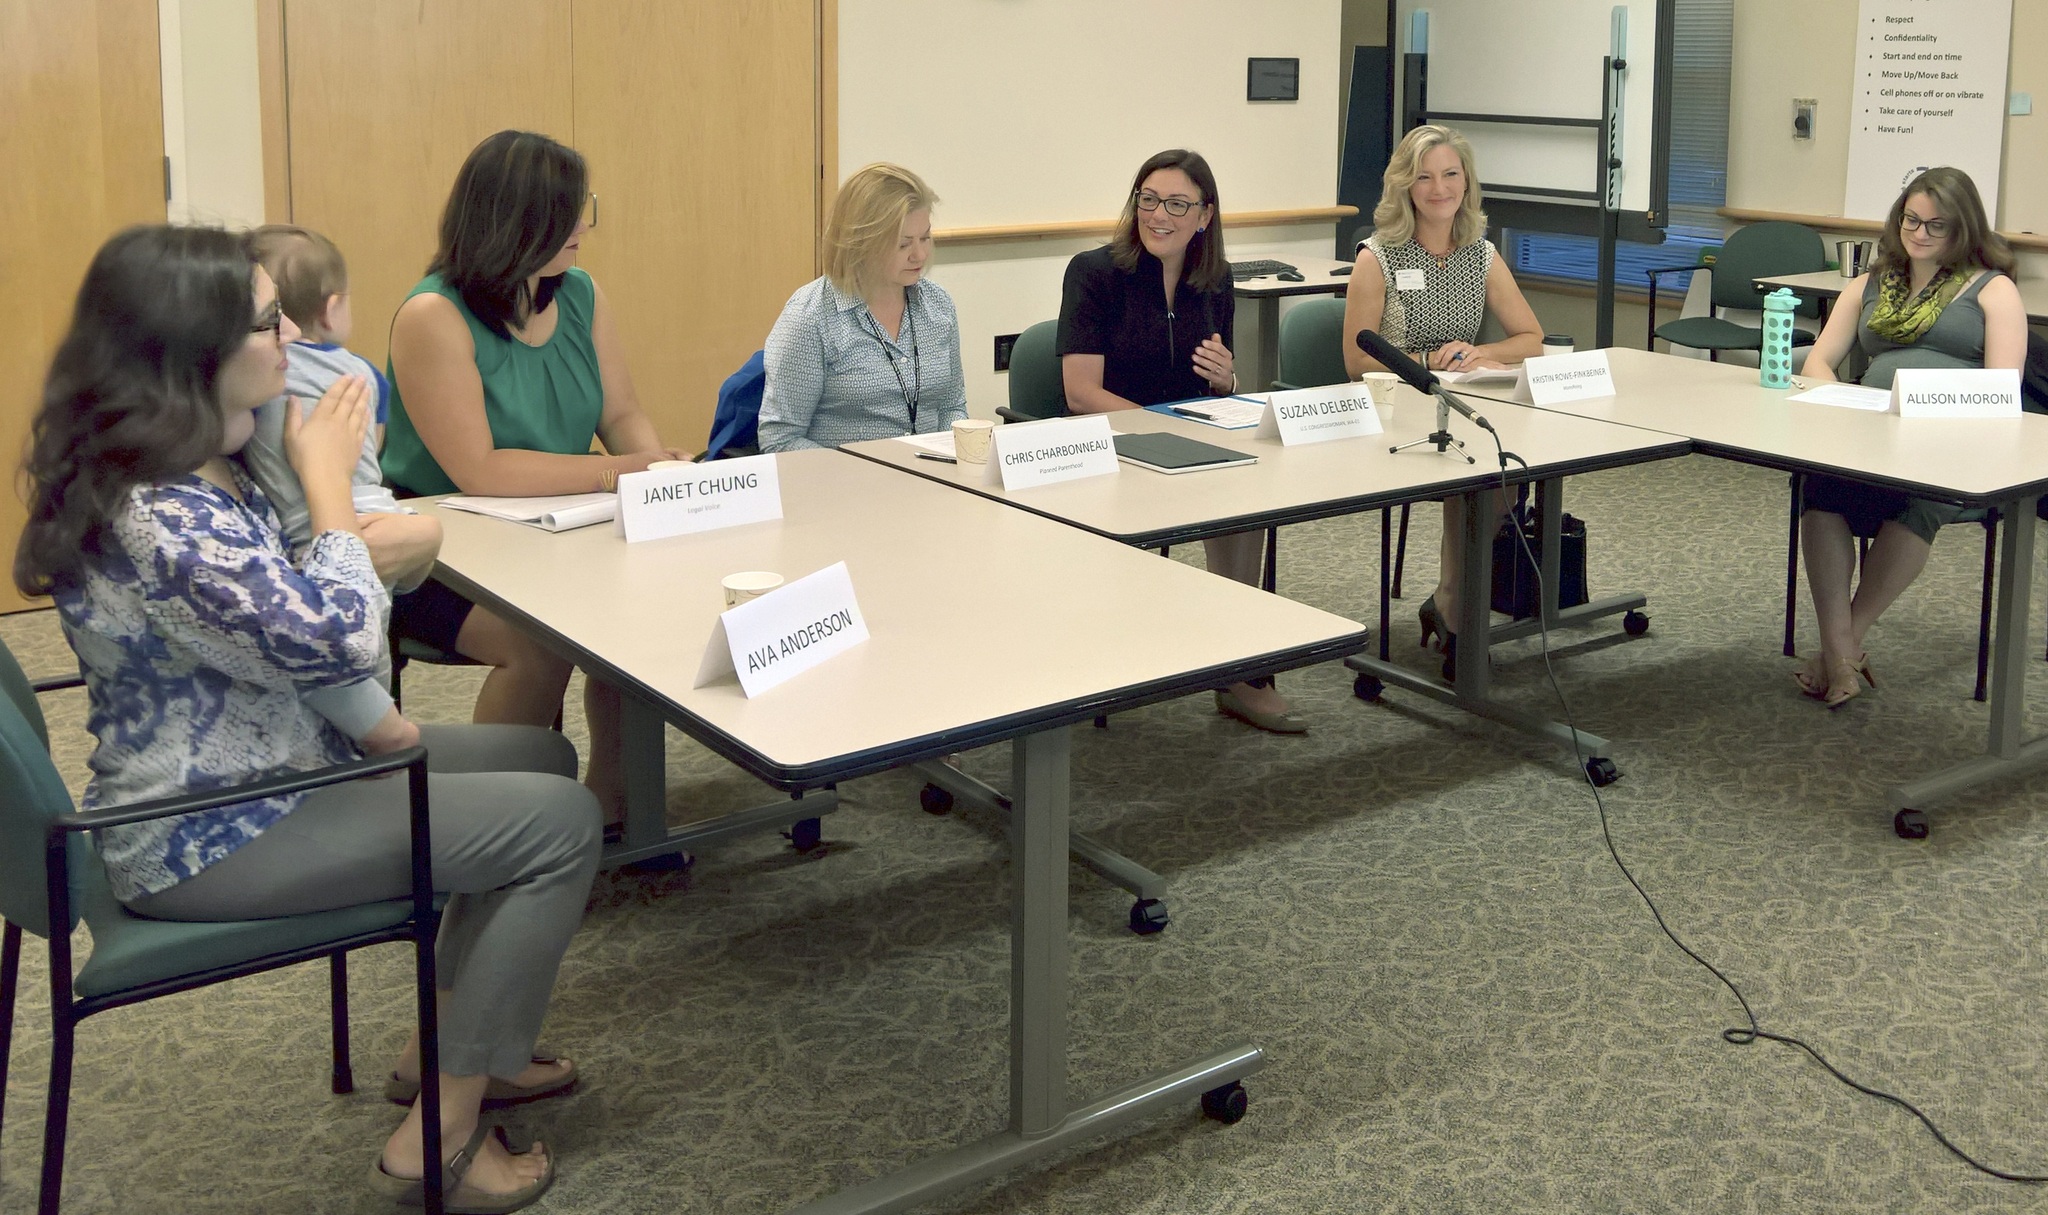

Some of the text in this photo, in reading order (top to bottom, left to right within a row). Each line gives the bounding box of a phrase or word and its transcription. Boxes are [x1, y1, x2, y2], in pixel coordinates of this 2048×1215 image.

[1885, 15, 1914, 24] Respect
[1884, 33, 1937, 43] Confidentiality
[1883, 52, 1900, 60] Start
[1917, 53, 1931, 61] end
[1944, 53, 1962, 62] time
[1881, 71, 1959, 80] Move Up/Move Back
[1880, 89, 1893, 97] Cell
[1895, 89, 1922, 98] phones
[1923, 90, 1934, 98] off
[1957, 91, 1984, 99] vibrate
[1879, 107, 1895, 115] Take
[1914, 108, 1922, 116] of
[1923, 109, 1954, 117] yourself
[1878, 125, 1913, 134] Have Fun!
[1532, 367, 1607, 384] KRISTIN ROWE-FINKBEINER
[1907, 393, 2013, 404] ALLISON MORONI
[1280, 404, 1318, 419] SUZAN
[1320, 397, 1369, 415] DELBENE
[1005, 439, 1109, 466] CHRIS CHARBONNEAU
[1039, 462, 1083, 474] Planned Parenthood
[643, 473, 758, 505] JANET CHUNG
[748, 608, 853, 674] AVA ANDERSON
